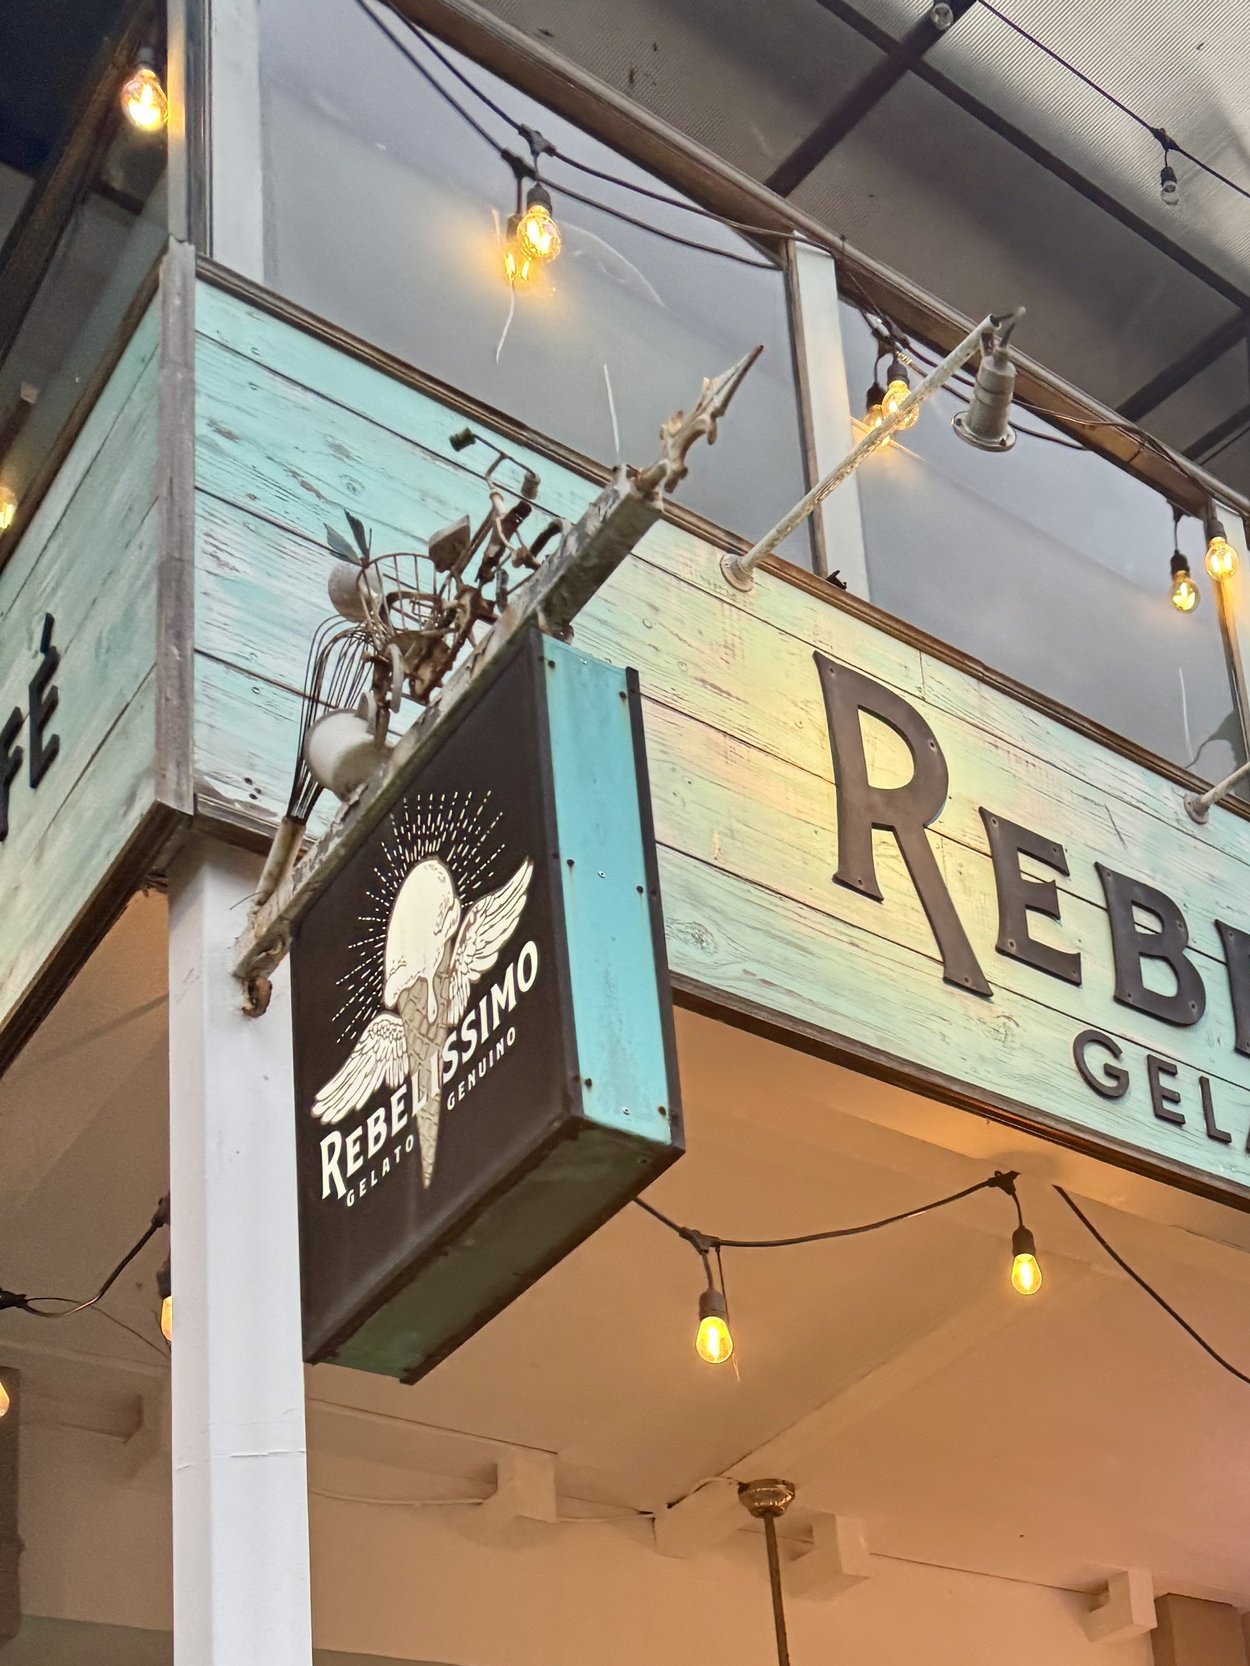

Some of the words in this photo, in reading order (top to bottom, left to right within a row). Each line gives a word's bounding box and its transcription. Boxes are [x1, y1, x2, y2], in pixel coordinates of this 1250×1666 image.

[319, 939, 539, 1203] REBELISSIMO
[346, 1134, 414, 1208] GELATO
[446, 1026, 517, 1112] GENUINO
